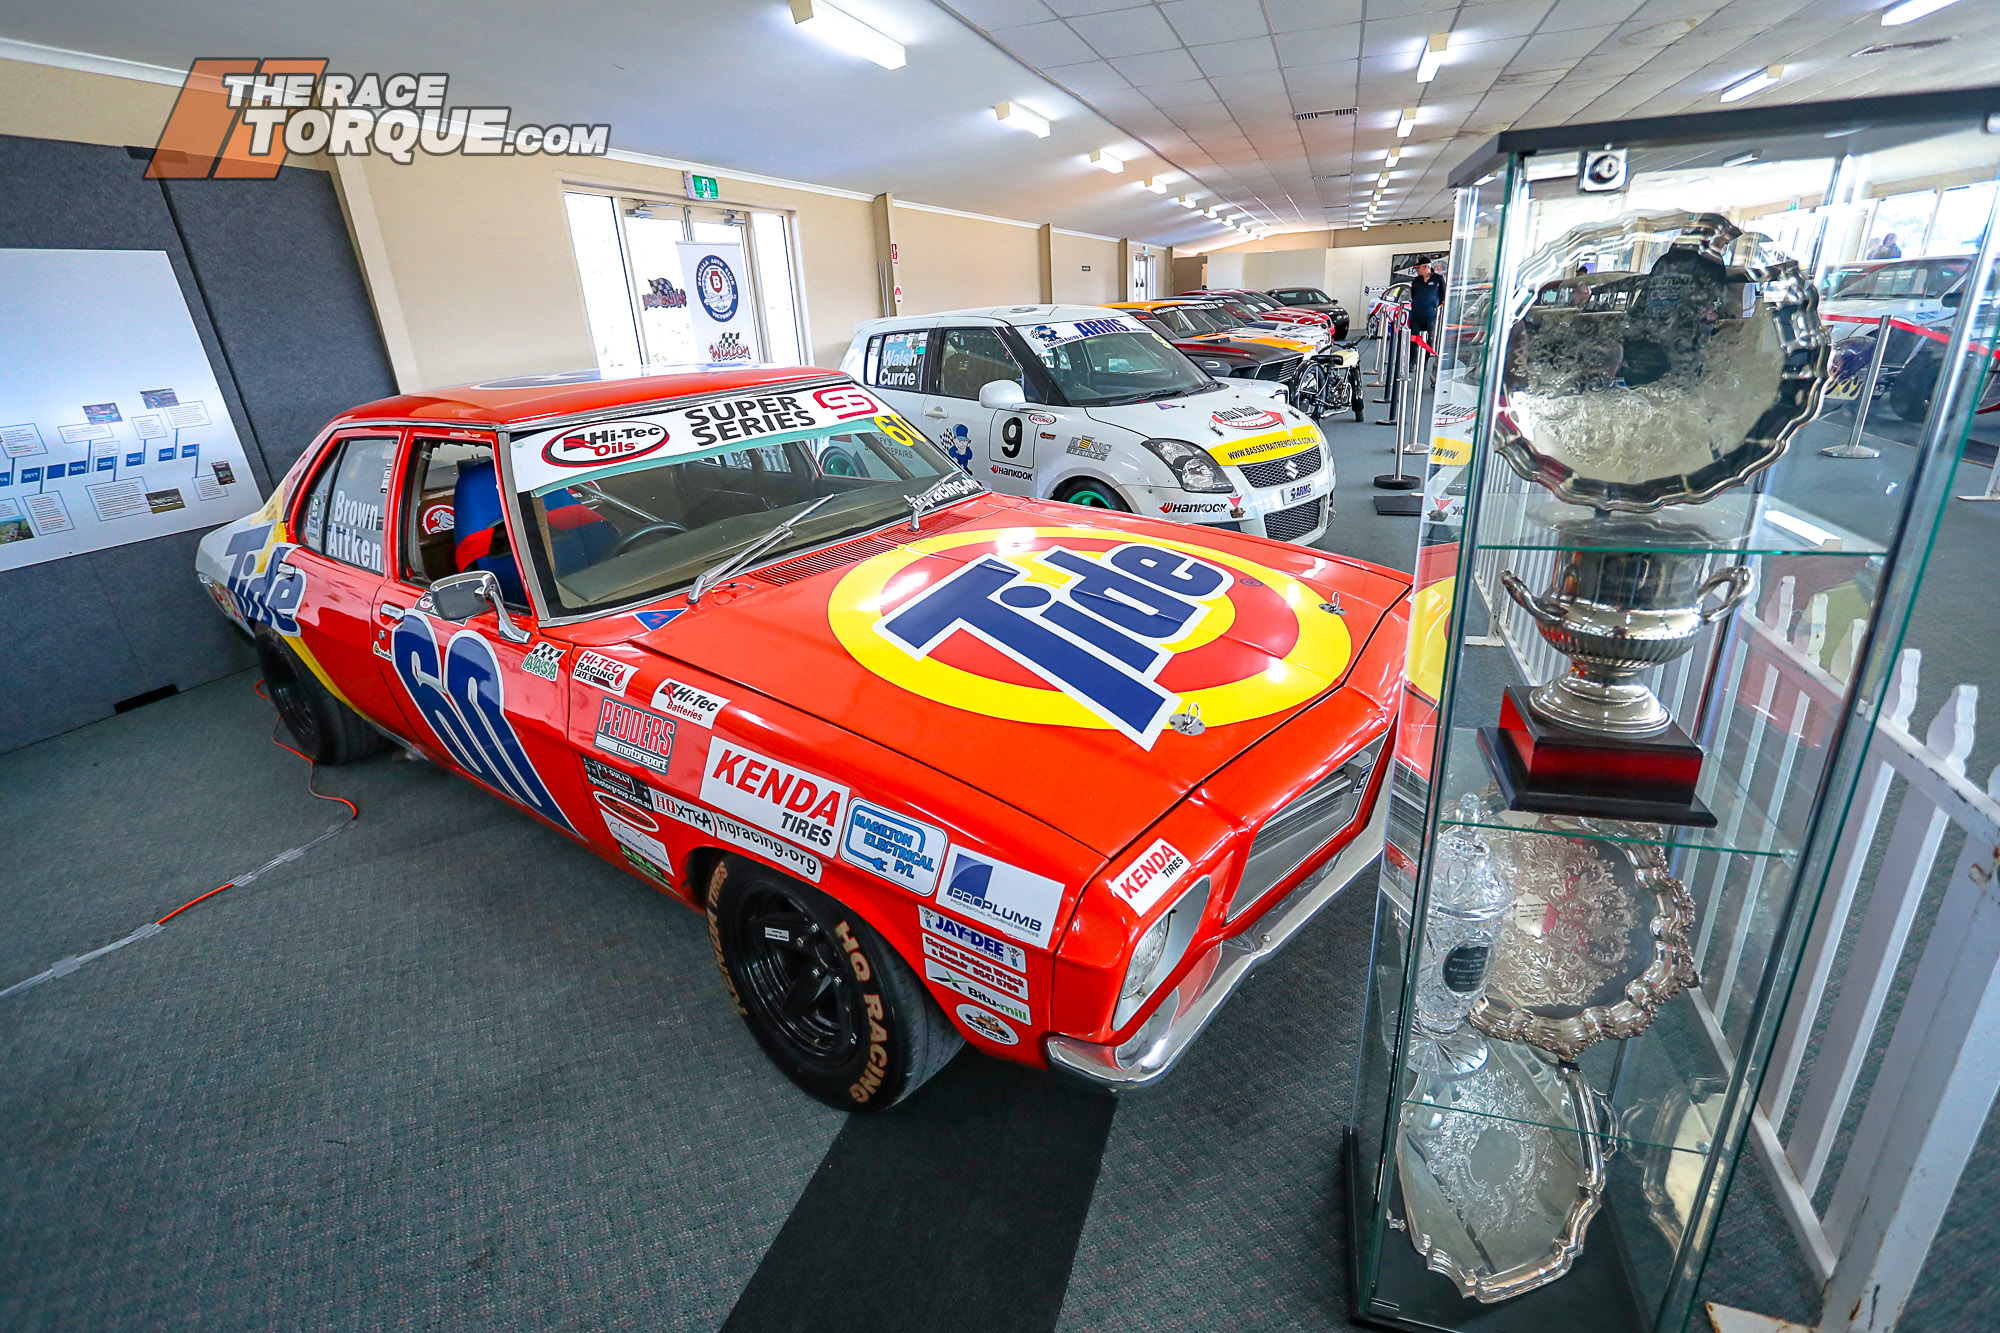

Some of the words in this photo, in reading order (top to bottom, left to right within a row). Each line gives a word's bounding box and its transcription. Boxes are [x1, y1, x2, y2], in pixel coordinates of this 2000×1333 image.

[1074, 318, 1131, 338] ARMS
[709, 342, 751, 361] Winton
[882, 350, 918, 368] Walsh
[879, 369, 916, 387] Currie
[684, 396, 803, 428] SUPER
[691, 410, 816, 446] SERIES
[873, 413, 928, 446] 60
[588, 426, 661, 445] Hi-Tec
[594, 442, 637, 456] Oils
[1002, 416, 1023, 459] 9
[1295, 484, 1312, 496] ARMS
[333, 490, 380, 531] Brown
[327, 522, 383, 572] Aitken
[225, 519, 307, 637] Tide
[581, 652, 624, 674] HI-TEC
[876, 544, 1232, 748] Tide
[524, 655, 559, 680] AASA
[575, 669, 595, 682] FUEL
[577, 662, 615, 681] RACING
[666, 702, 703, 721] Batteries
[675, 687, 718, 712] Hi-Tec
[391, 608, 584, 839] 60
[598, 699, 675, 757] PEDDERS
[617, 744, 668, 780] motorsport
[712, 748, 841, 828] KENDA
[716, 816, 817, 876] hqracing.org
[780, 811, 833, 847] TIRES
[854, 813, 915, 848] MAGILTON
[863, 832, 935, 873] ELECTRICAL
[893, 860, 915, 880] P/L
[1161, 856, 1184, 878] TIRES
[1119, 844, 1177, 900] KENDA
[950, 898, 987, 919] PROFESSIONAL
[986, 914, 1014, 930] PLUMBING
[1013, 924, 1040, 938] SERVICES
[951, 887, 1043, 932] PROPLUMB
[835, 920, 871, 982] HQ
[935, 916, 1005, 957] JAY-DEE
[975, 946, 988, 956] AUTO
[988, 951, 1004, 962] CABLES
[959, 953, 992, 972] Holden
[993, 967, 1025, 988] Wreck
[968, 986, 1027, 1021] Bitu-mill
[849, 993, 888, 1103] RACING
